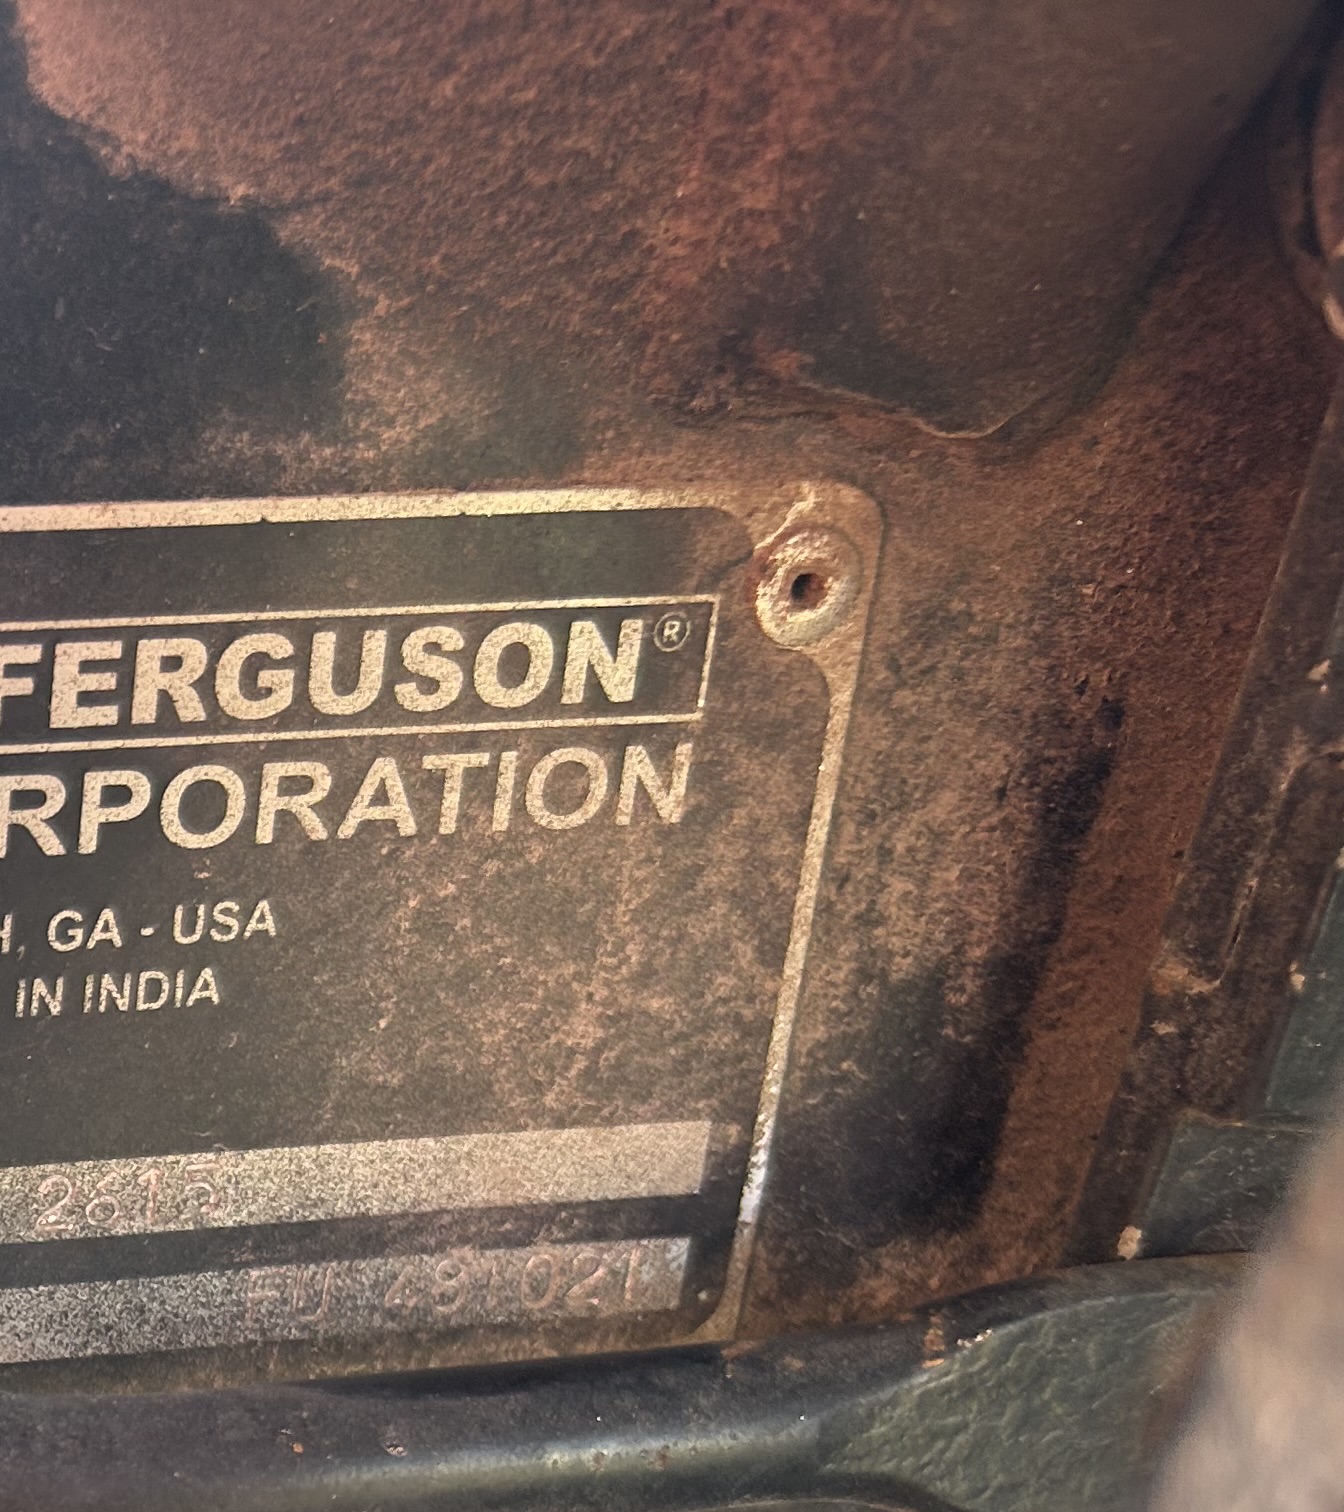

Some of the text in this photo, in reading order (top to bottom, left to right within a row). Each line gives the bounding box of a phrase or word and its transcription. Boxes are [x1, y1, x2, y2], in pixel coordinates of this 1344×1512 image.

[46, 908, 123, 953] GA
[172, 900, 278, 945] USA
[14, 975, 62, 1018] IN
[83, 967, 220, 1014] INDIA
